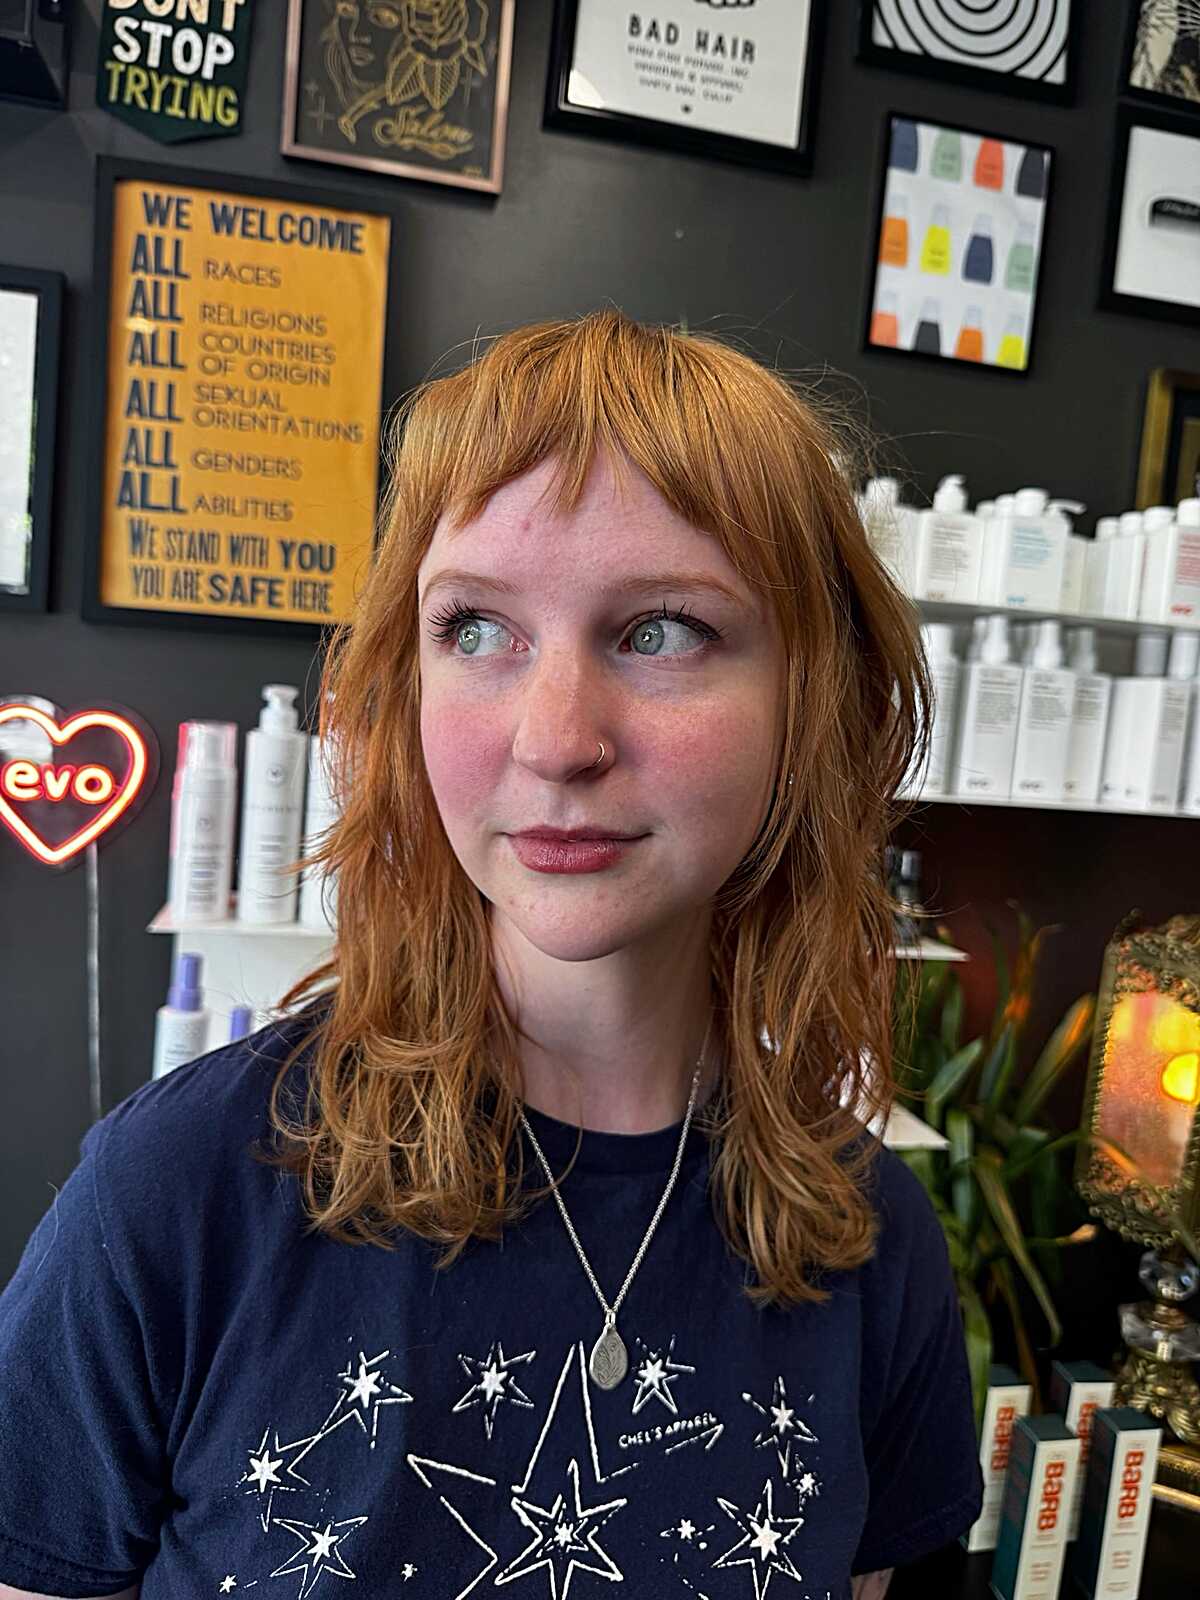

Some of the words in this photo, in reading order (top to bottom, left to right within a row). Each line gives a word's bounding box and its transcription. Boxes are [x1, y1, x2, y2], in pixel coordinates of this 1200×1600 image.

[112, 16, 235, 80] STOP
[628, 14, 679, 45] BAD
[695, 29, 756, 64] HAIR
[104, 60, 240, 127] TRYING
[142, 191, 192, 231] WE
[209, 202, 366, 255] WELCOME
[131, 234, 191, 280] ALL
[203, 258, 282, 289] RACES
[129, 279, 184, 322] ALL
[200, 303, 328, 337] RELIGIONS
[128, 330, 186, 371] ALL
[200, 331, 336, 366] COUNTRIES
[199, 355, 236, 377] OF
[245, 359, 332, 387] ORIGIN
[125, 379, 183, 423] ALL
[195, 383, 287, 412] SEXUAL
[192, 407, 364, 444] ORIENTATIONS
[122, 427, 178, 469] ALL
[191, 450, 303, 482] GENDERS
[116, 471, 187, 513] ALL
[193, 496, 294, 524] ABILITIES
[128, 517, 160, 560] WE
[166, 528, 221, 566] STAND
[230, 533, 271, 568] WITH
[279, 540, 337, 573] YOU
[131, 565, 165, 599] YOU
[171, 568, 204, 603] ARE
[208, 573, 285, 609] SAFE
[290, 579, 333, 614] HERE
[4, 760, 115, 803] evo
[664, 1412, 717, 1434] APPAREL
